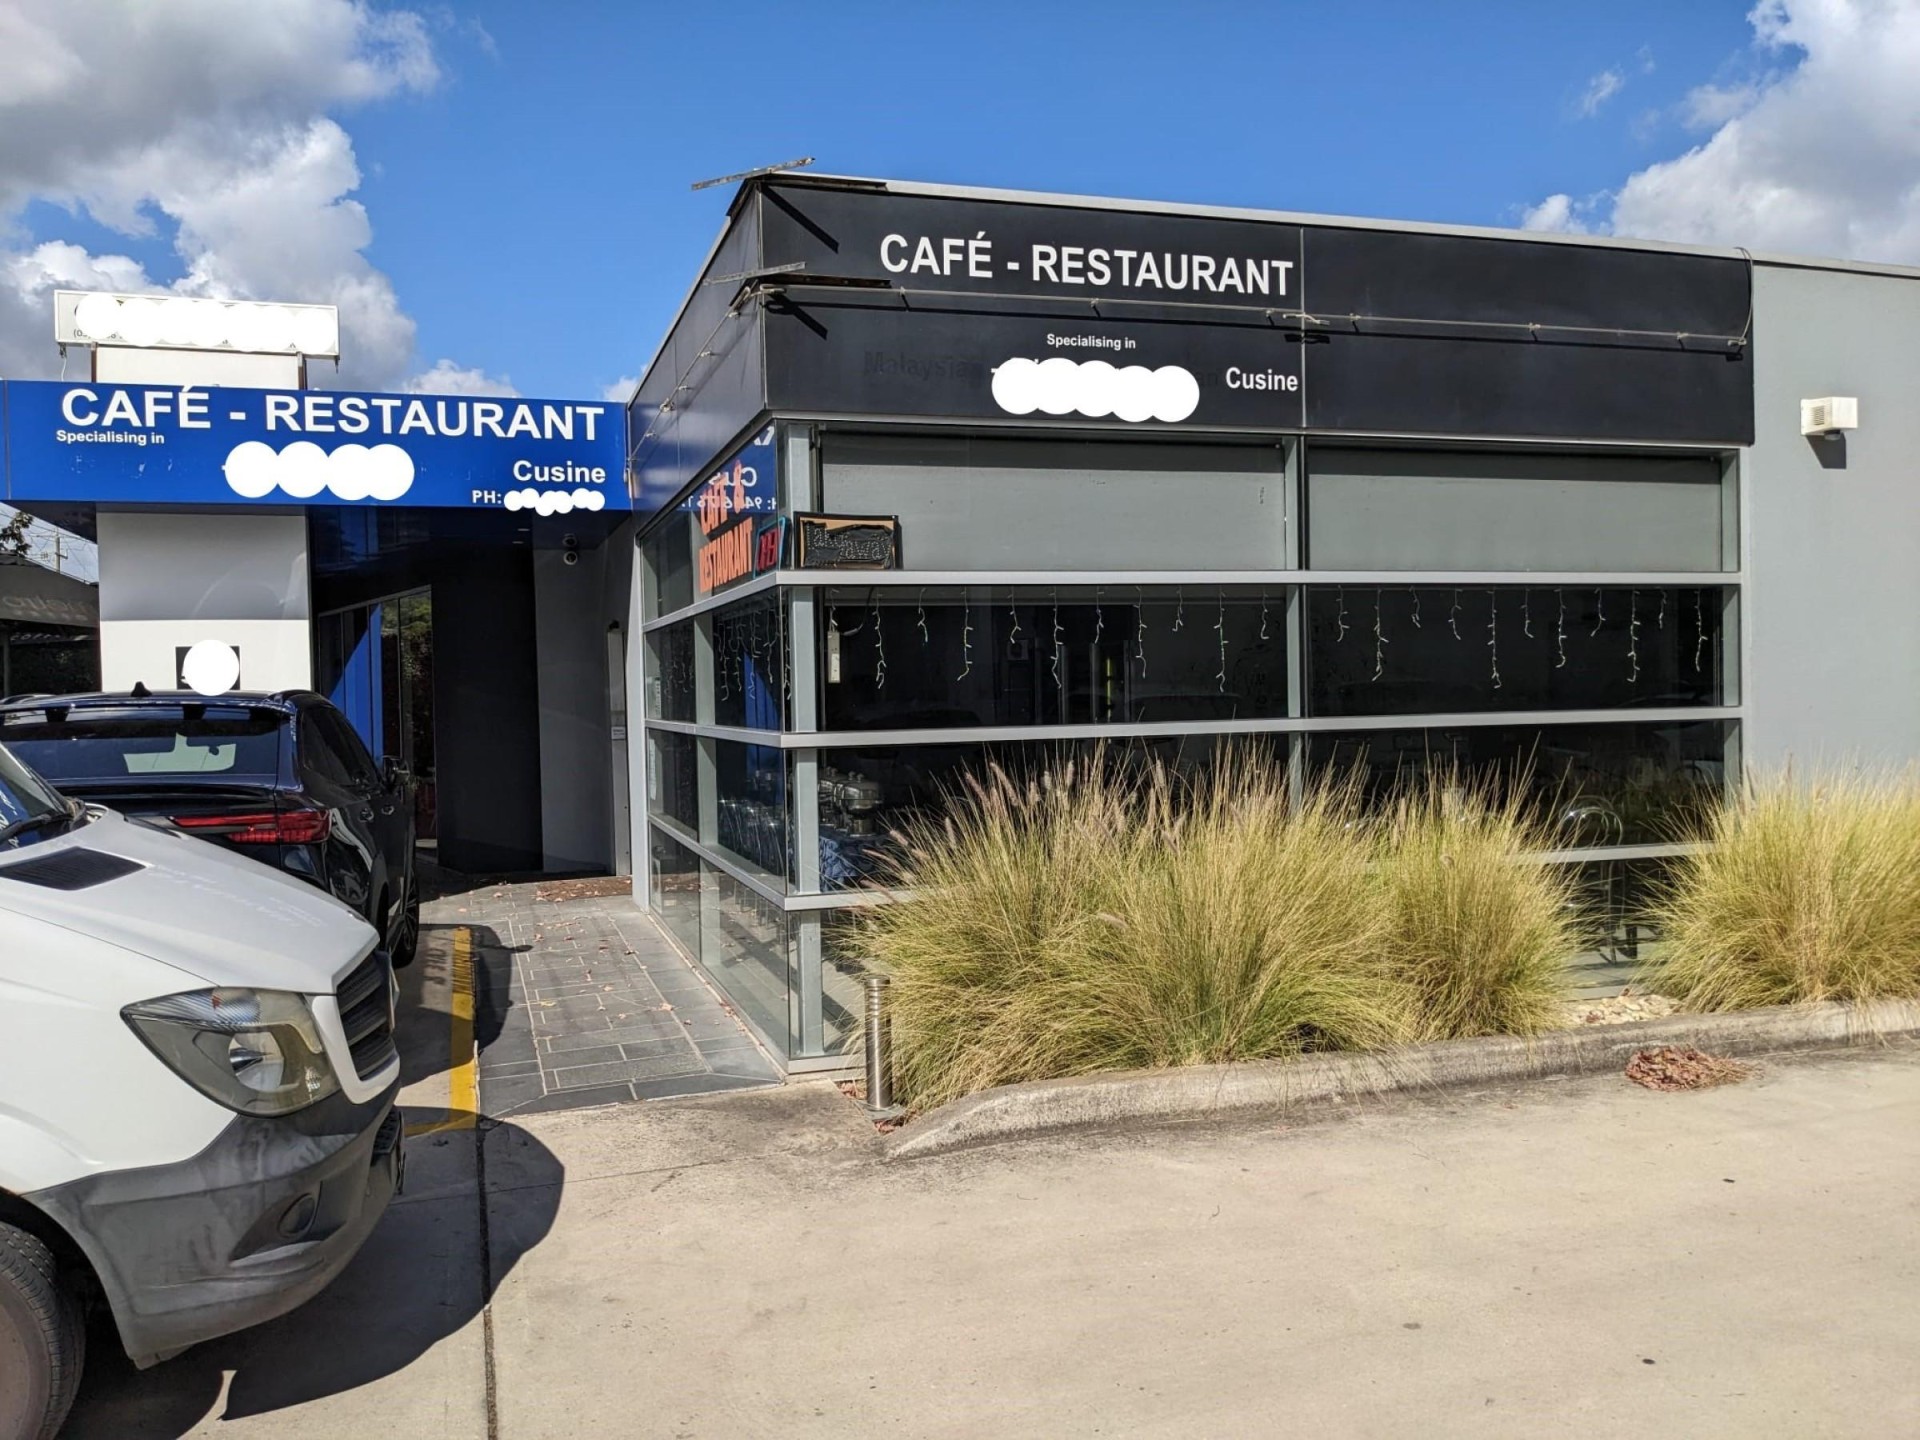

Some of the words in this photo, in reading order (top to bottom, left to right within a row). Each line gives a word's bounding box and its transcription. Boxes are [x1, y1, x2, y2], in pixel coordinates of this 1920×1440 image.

[880, 230, 993, 278] CAFÉ
[1032, 244, 1294, 296] RESTAURANT
[1046, 333, 1122, 351] Specialising
[1124, 337, 1136, 349] in
[1225, 366, 1299, 392] Cusine
[61, 386, 212, 429] CAFÉ
[265, 394, 605, 441] RESTAURANT
[56, 429, 147, 446] Specialising
[151, 432, 165, 444] in
[513, 460, 606, 484] Cusine
[472, 489, 502, 504] PH:
